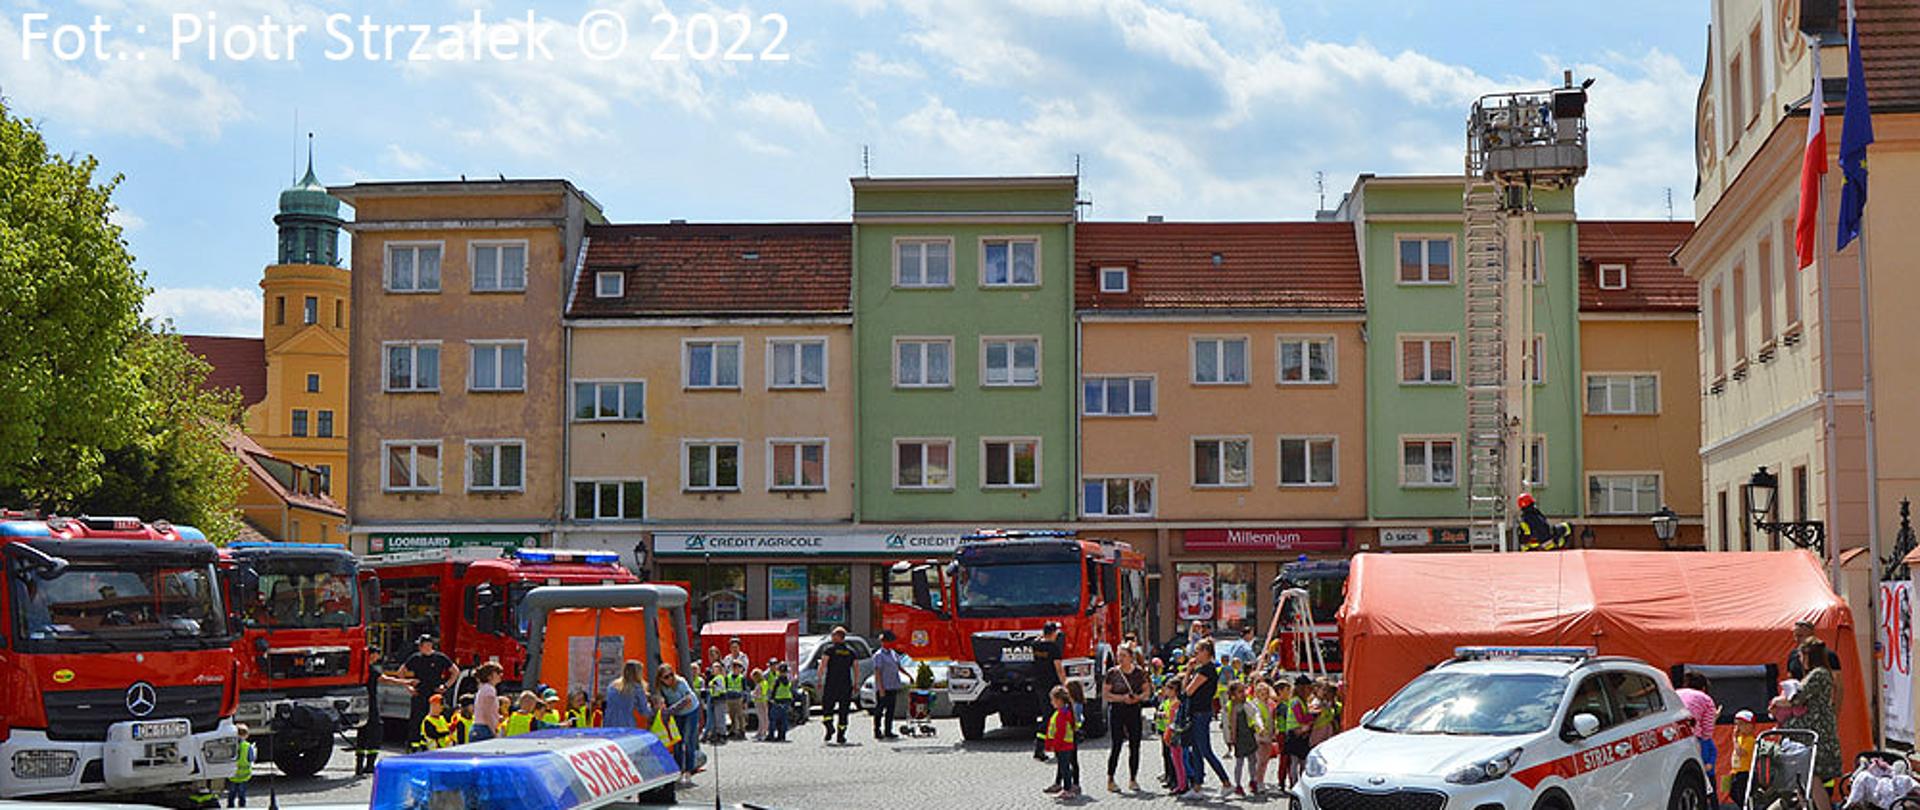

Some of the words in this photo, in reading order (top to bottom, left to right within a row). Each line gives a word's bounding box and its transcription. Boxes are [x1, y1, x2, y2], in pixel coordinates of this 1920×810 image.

[388, 537, 450, 547] LOOMBARD
[758, 537, 823, 547] AGRICOLE
[1227, 529, 1300, 544] Millennium
[569, 744, 641, 797] STRAŻ
